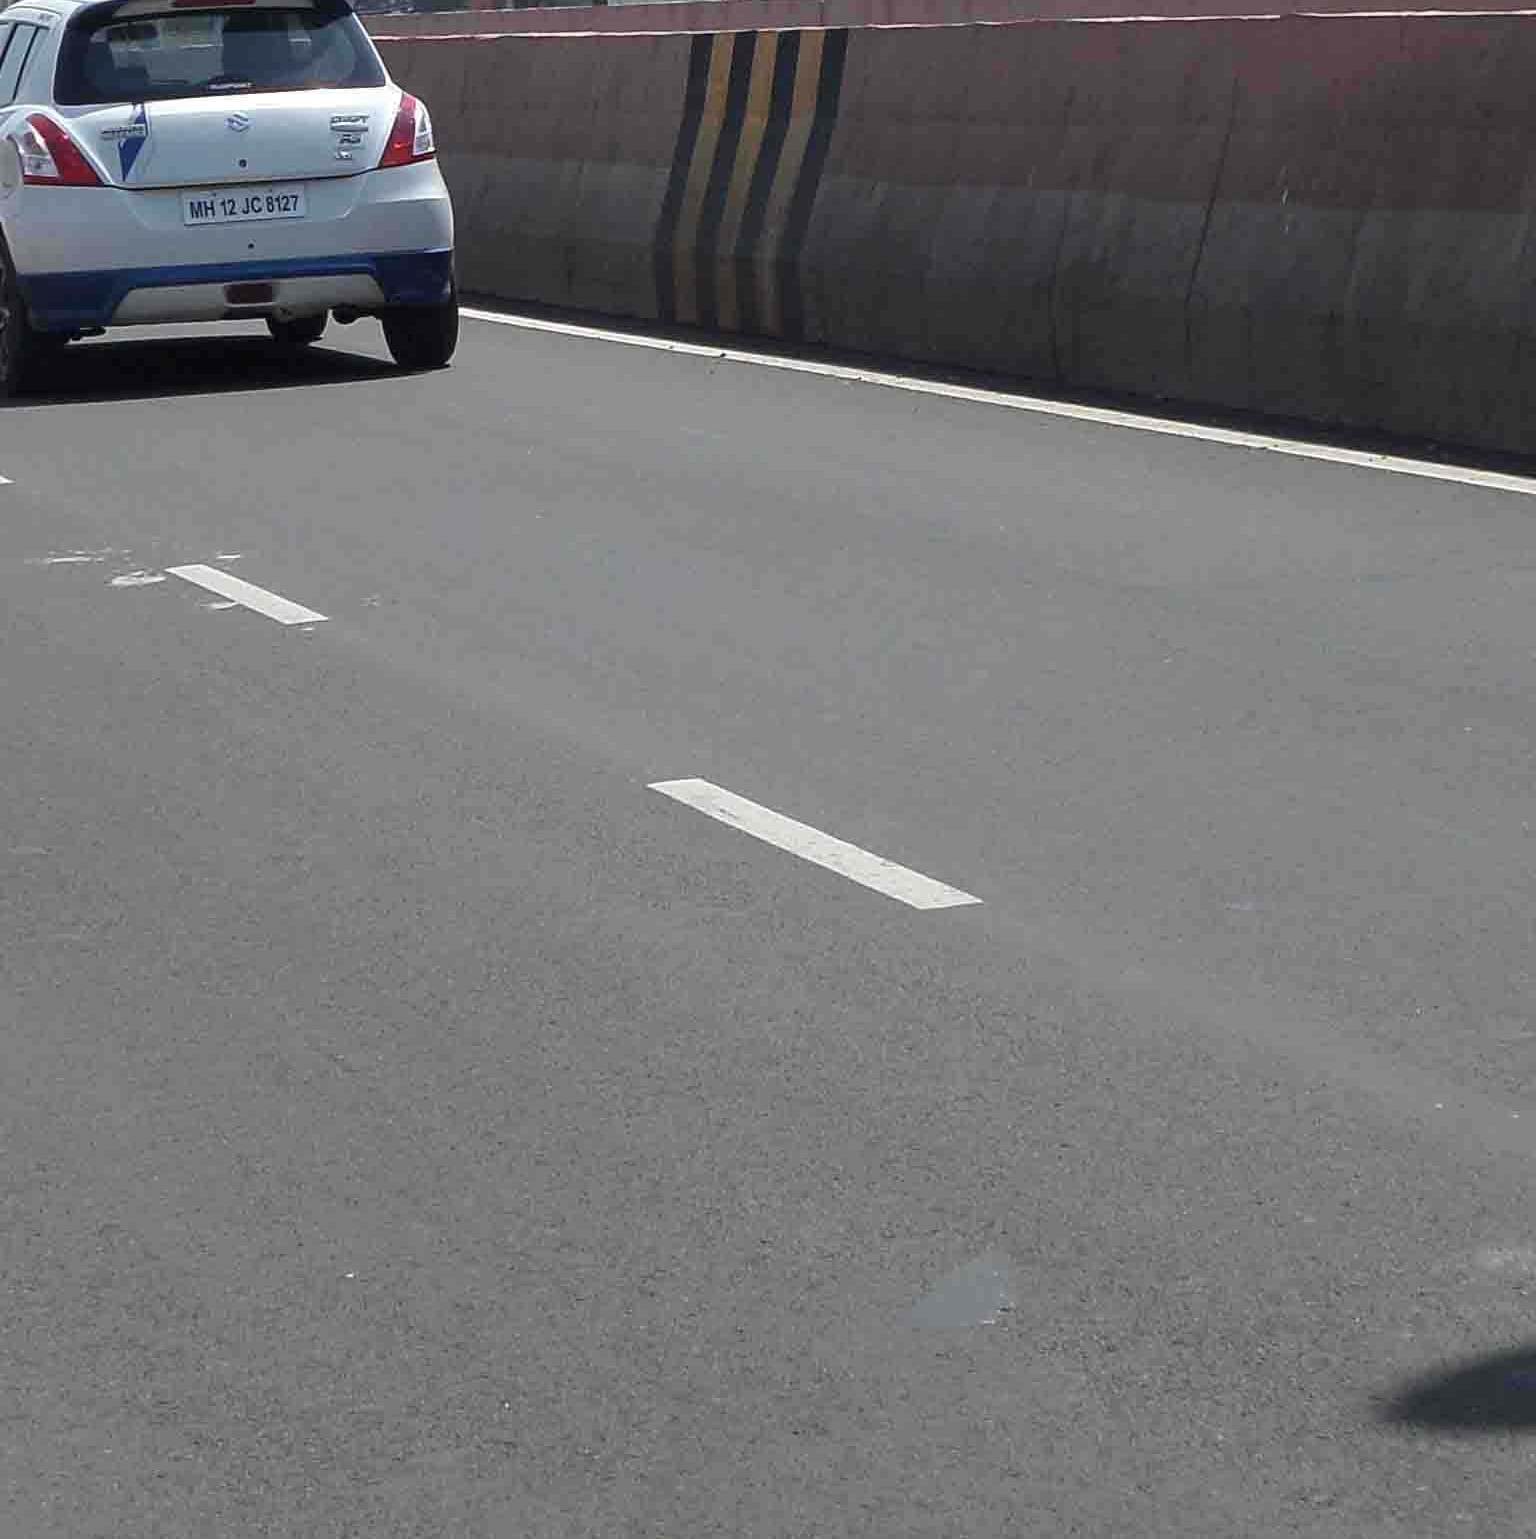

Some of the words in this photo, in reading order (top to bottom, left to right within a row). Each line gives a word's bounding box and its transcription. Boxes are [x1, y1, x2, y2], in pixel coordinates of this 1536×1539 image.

[189, 200, 216, 219] MH
[220, 198, 237, 216] 12
[241, 196, 263, 214] JC
[266, 194, 299, 213] 8127
